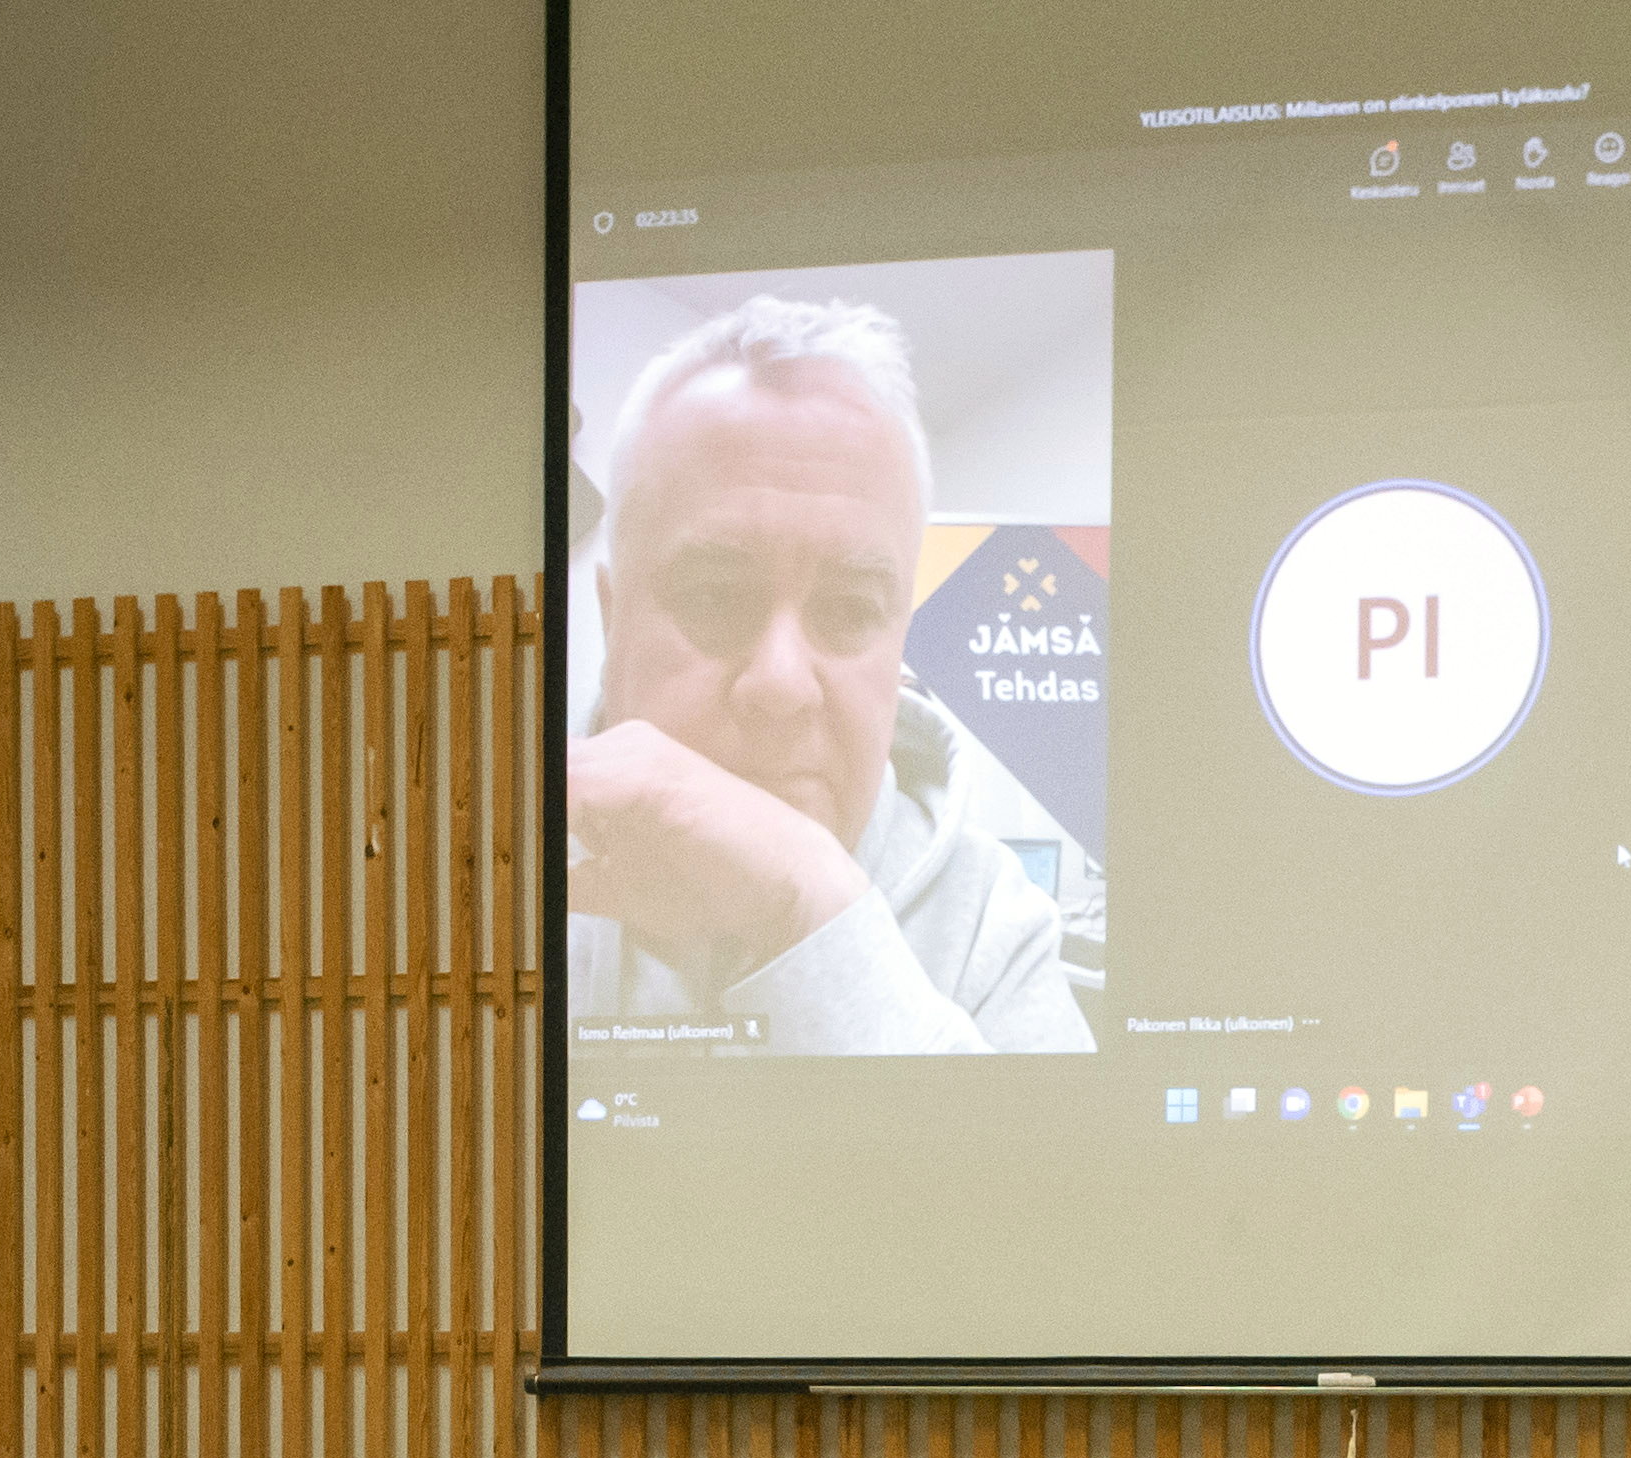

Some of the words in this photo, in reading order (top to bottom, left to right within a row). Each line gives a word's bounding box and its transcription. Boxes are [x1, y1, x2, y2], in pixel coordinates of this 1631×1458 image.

[1285, 101, 1360, 119] Millainen
[1363, 99, 1386, 114] on
[1356, 595, 1441, 682] PI
[973, 668, 1100, 702] Tehdas
[578, 1026, 610, 1041] Ismo
[668, 1023, 735, 1041] (ulkoinen)
